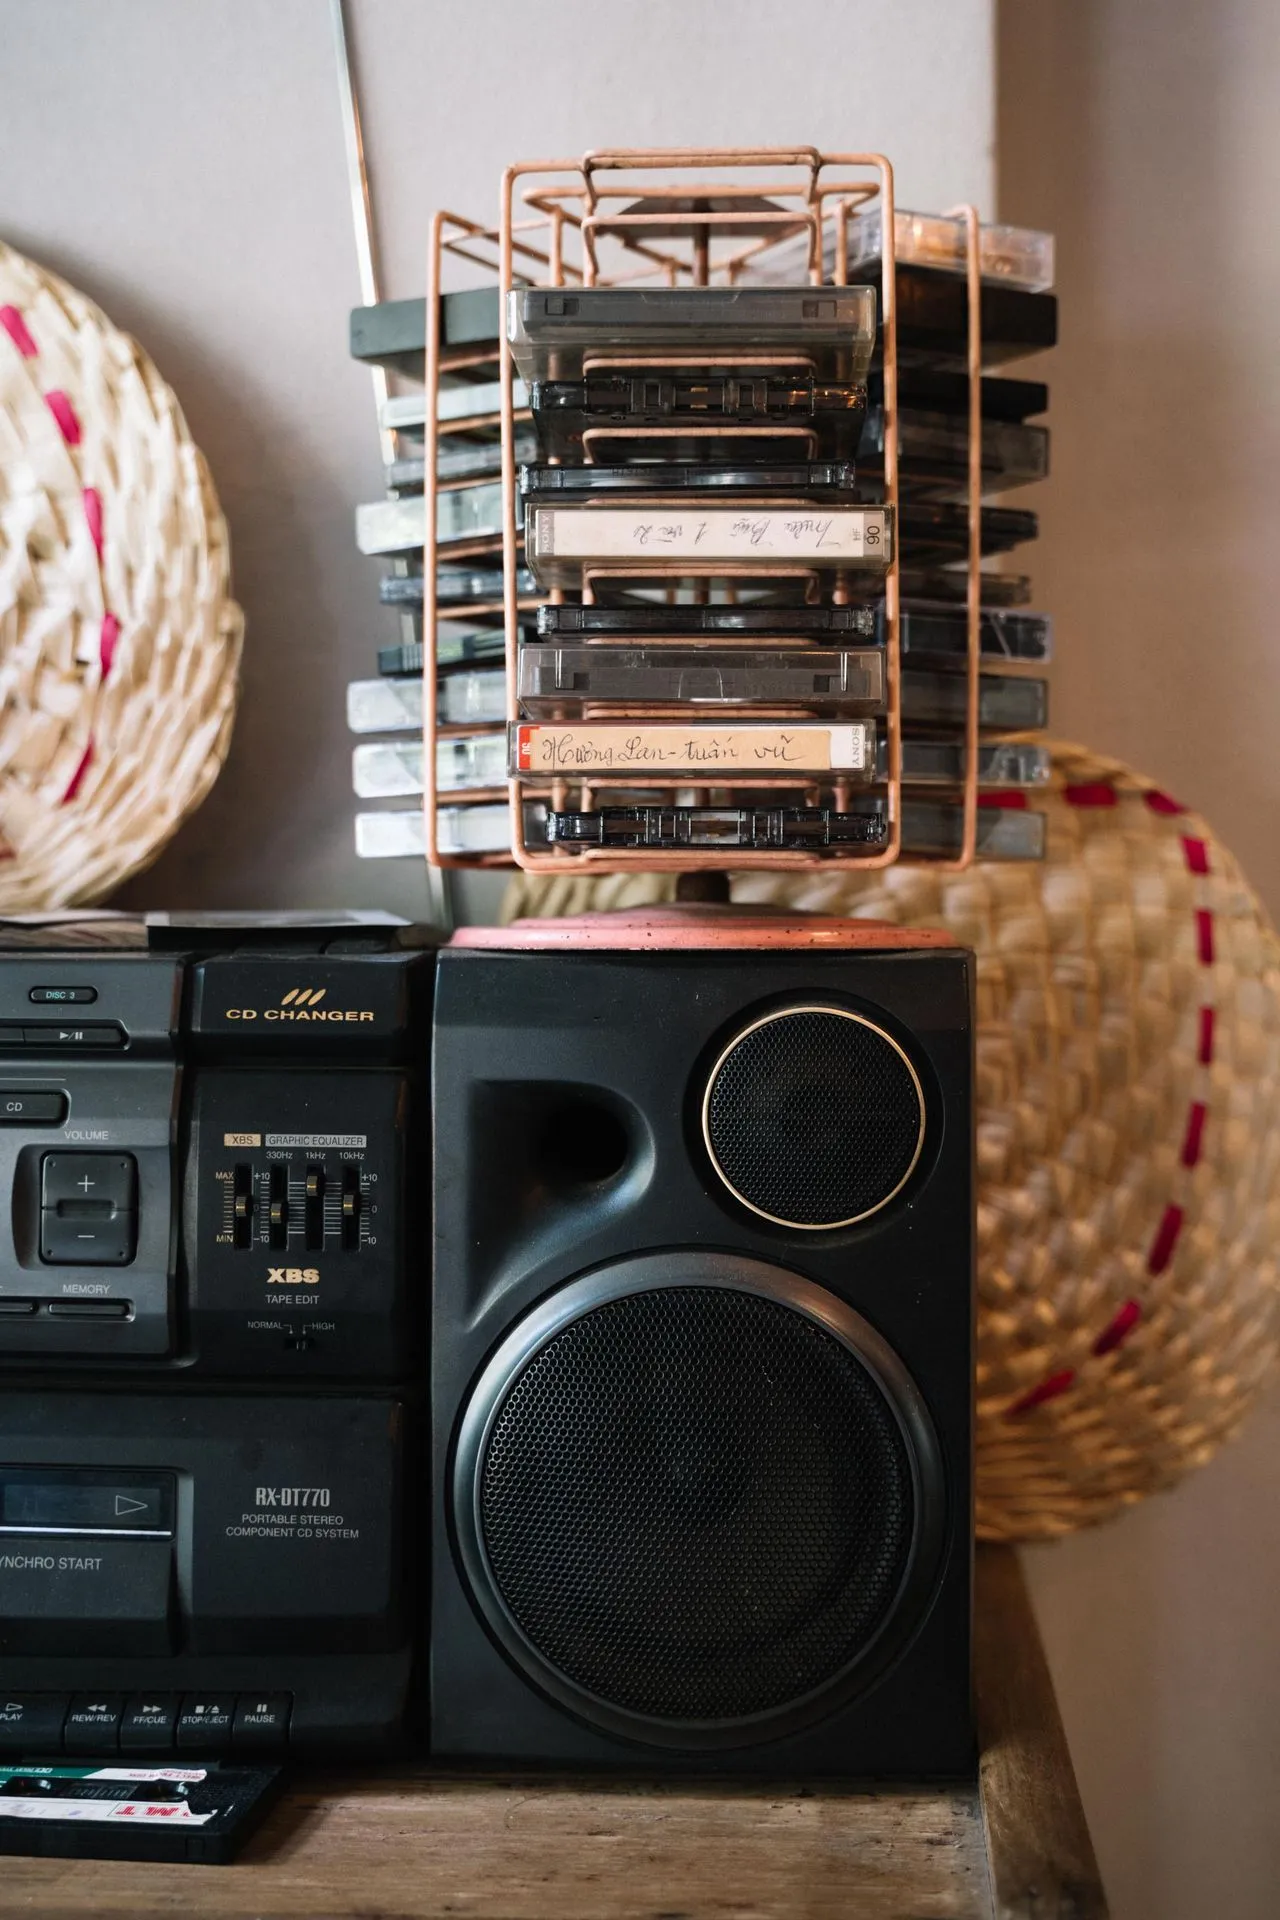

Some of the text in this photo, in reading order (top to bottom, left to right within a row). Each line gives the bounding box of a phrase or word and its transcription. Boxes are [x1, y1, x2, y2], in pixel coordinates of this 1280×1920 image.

[541, 515, 550, 553] SONY
[866, 525, 880, 545] 90
[852, 727, 860, 766] SONY
[45, 991, 76, 999] DISC 3
[225, 1009, 374, 1021] CD CHANGER
[6, 1102, 23, 1112] CD
[64, 1131, 109, 1140] VOLUME
[232, 1135, 253, 1145] XBS
[269, 1135, 364, 1146] GRAPHIC EQUALIZER
[266, 1151, 293, 1160] 330Hz
[305, 1151, 326, 1160] 1kHz
[339, 1151, 365, 1160] 10kHz
[215, 1171, 234, 1179] MAX
[254, 1172, 271, 1180] +10
[361, 1173, 378, 1182] +10
[216, 1235, 234, 1243] MIN
[253, 1235, 270, 1243] -10
[361, 1236, 377, 1245] -10
[266, 1268, 320, 1283] XBS
[62, 1284, 111, 1294] MEMORY
[265, 1294, 320, 1304] TAPE EDIT
[248, 1321, 284, 1329] NORMAL
[312, 1322, 336, 1331] HIGH
[255, 1487, 331, 1507] RX-DT770
[241, 1513, 344, 1525] PORTABLE STEREO
[226, 1526, 359, 1539] COMPONENT CD SYSTEM
[58, 1557, 103, 1571] START
[0, 1713, 23, 1721] PLAY
[71, 1714, 117, 1722] REW/REV
[133, 1715, 167, 1724] FF/CUE
[244, 1715, 275, 1723] PAUSE
